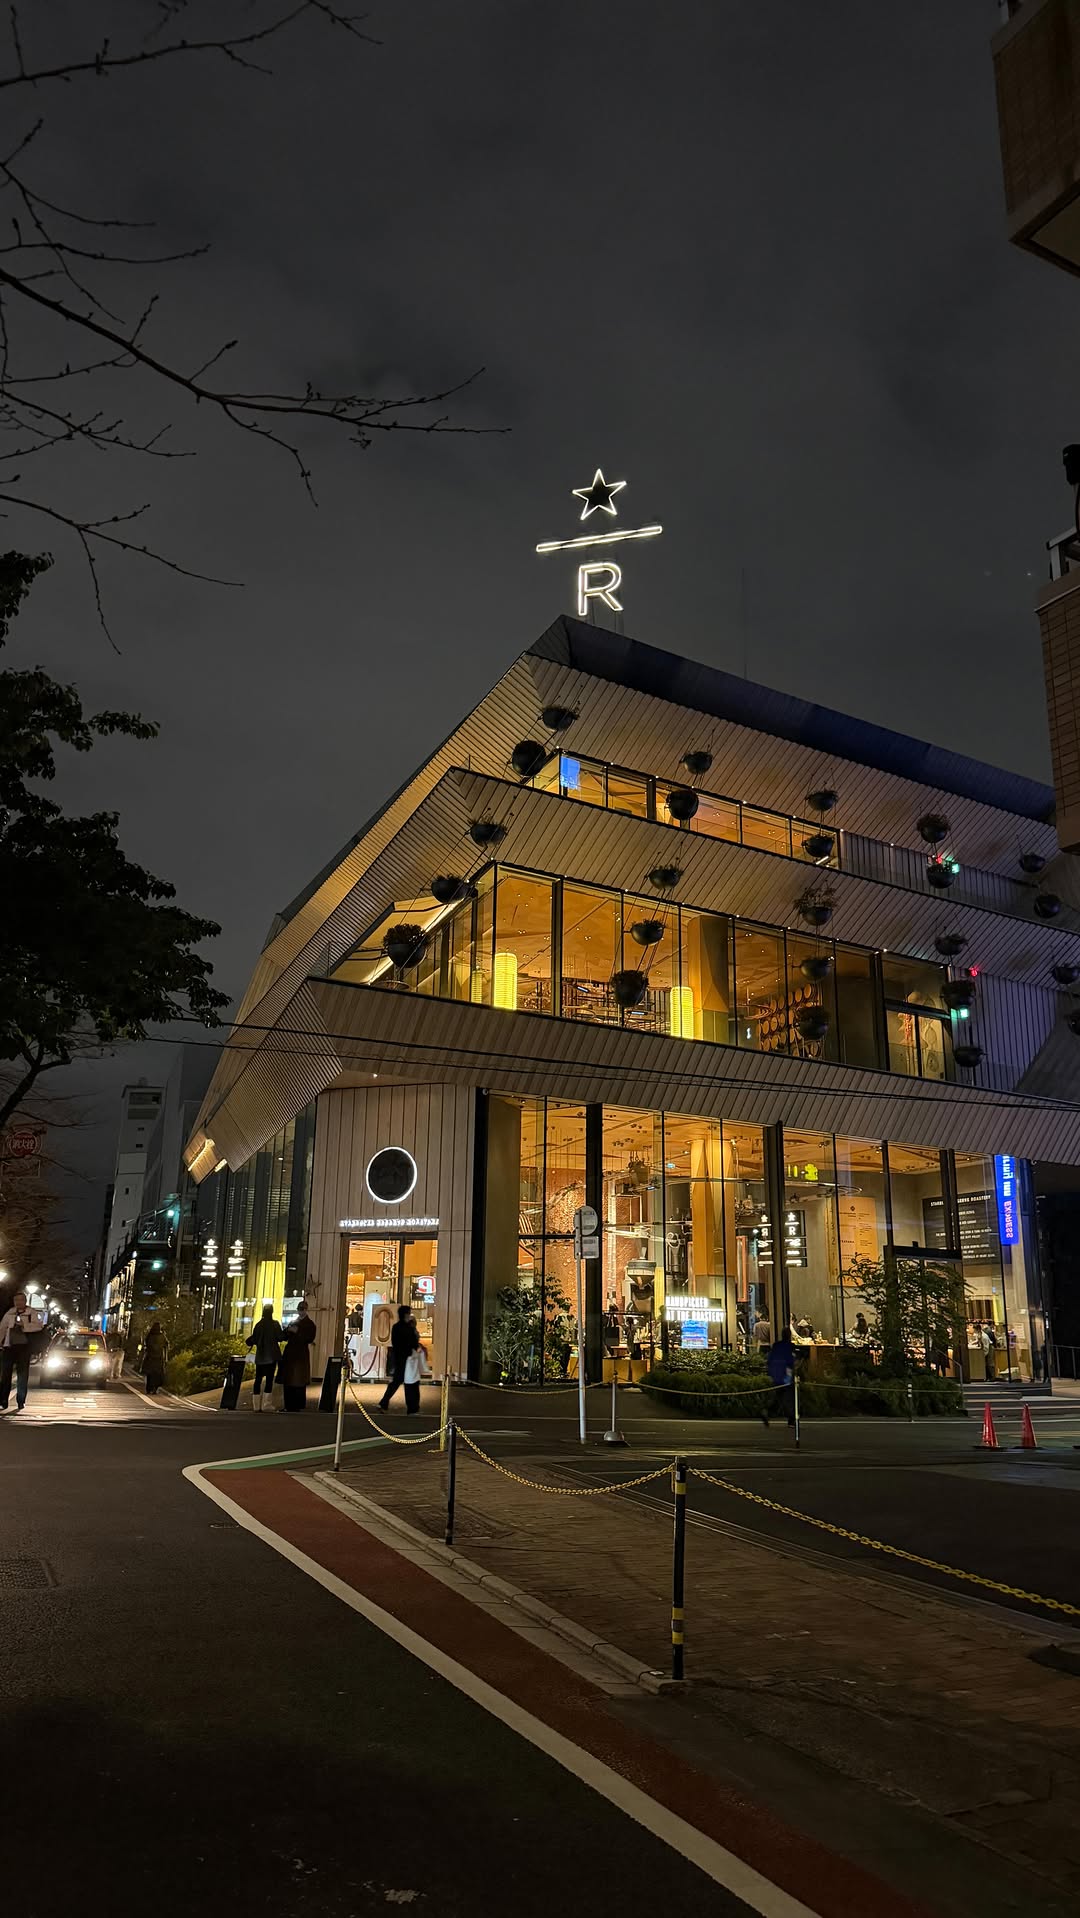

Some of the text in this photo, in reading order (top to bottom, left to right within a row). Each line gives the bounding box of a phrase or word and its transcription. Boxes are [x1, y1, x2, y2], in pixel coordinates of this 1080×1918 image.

[577, 562, 624, 616] R
[665, 1296, 708, 1307] HANDPICKED
[666, 1310, 724, 1322] AT THE ROASTERY
